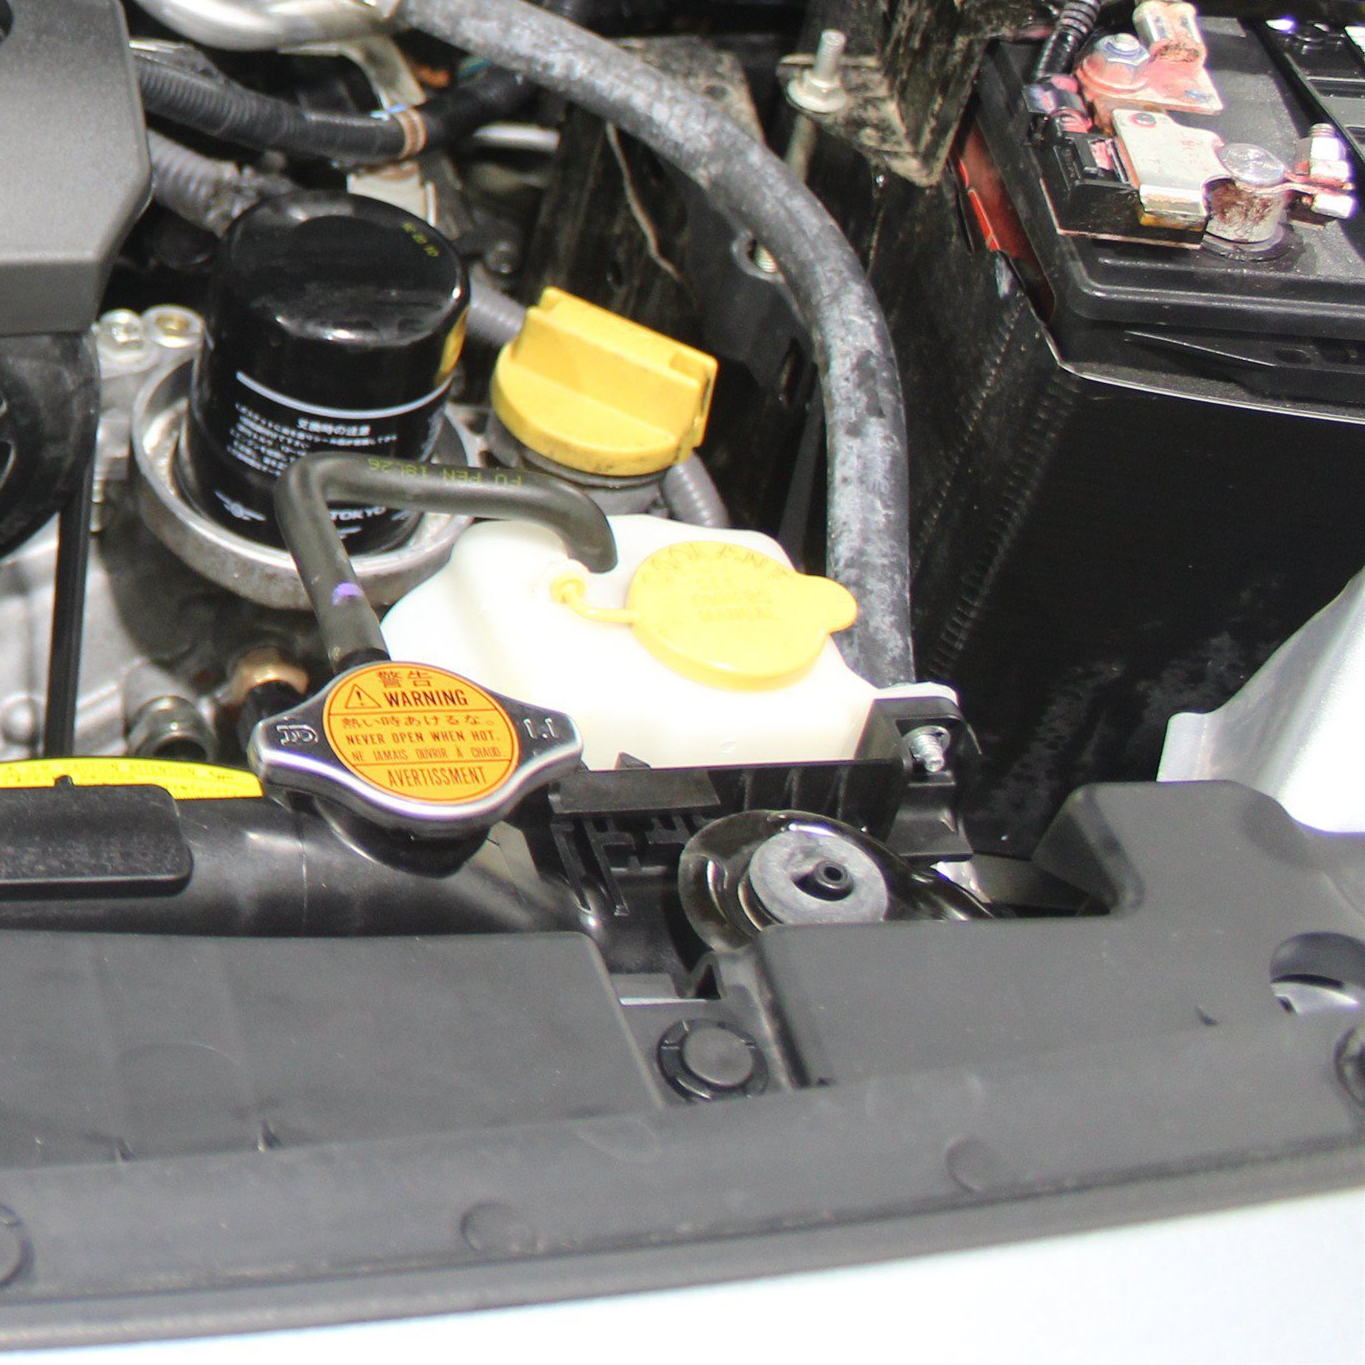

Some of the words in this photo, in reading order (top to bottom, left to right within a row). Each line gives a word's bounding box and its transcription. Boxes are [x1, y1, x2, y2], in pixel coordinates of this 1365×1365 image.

[377, 670, 433, 688] 警告
[382, 689, 468, 708] WARNING
[342, 714, 495, 729] 熱い時あけるな。
[346, 733, 385, 746] NEVER
[393, 731, 424, 744] OPEN
[430, 730, 466, 742] WHEN
[472, 729, 501, 741] HOT.
[352, 750, 365, 762] NE
[416, 748, 448, 760] OUVRIR
[387, 766, 488, 788] AVERTISSMENT
